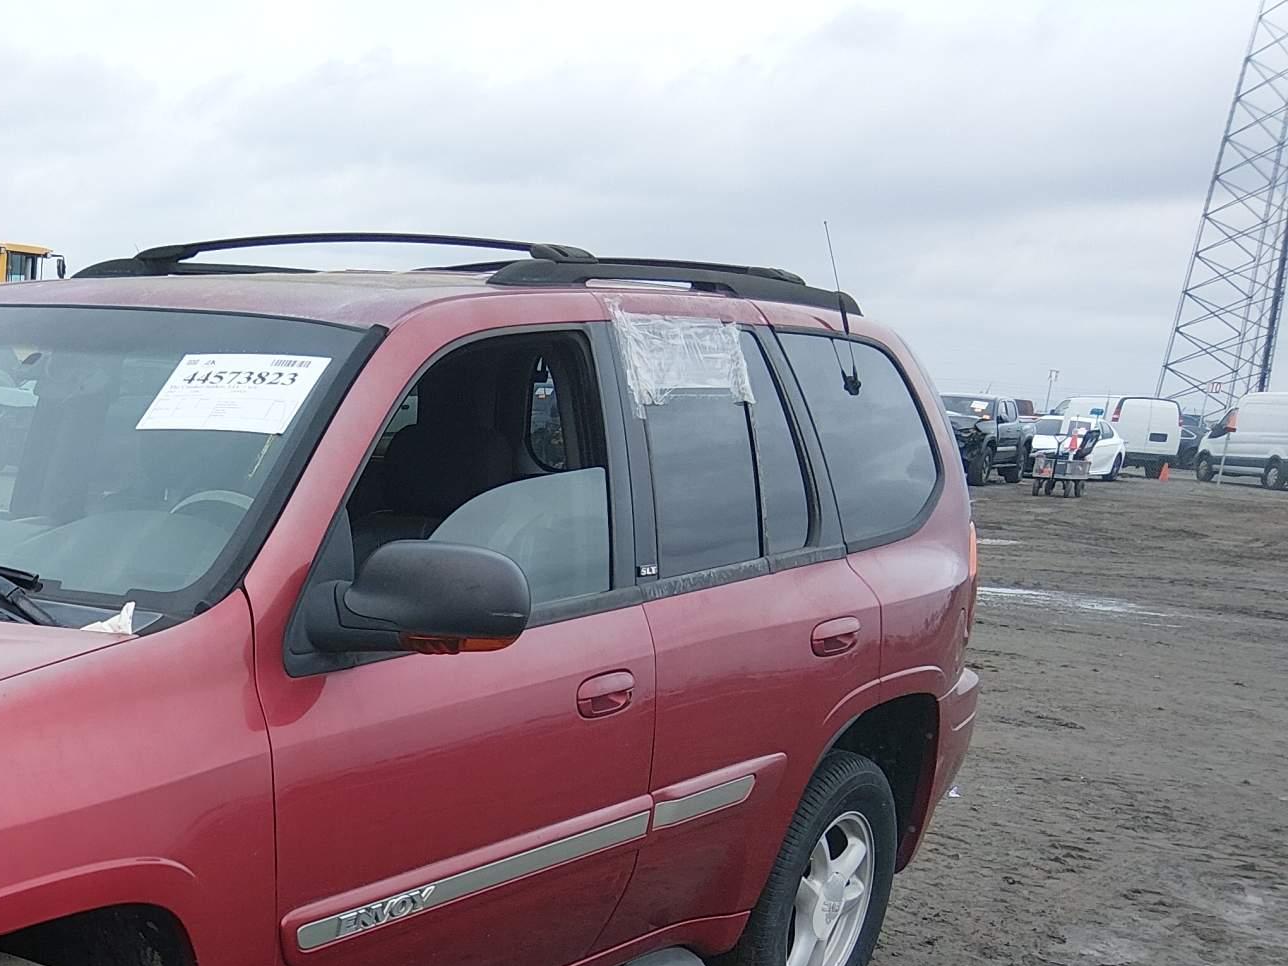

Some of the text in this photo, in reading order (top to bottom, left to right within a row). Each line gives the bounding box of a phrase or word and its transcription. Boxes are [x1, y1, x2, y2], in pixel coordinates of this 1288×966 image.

[183, 370, 300, 386] 44573823
[640, 566, 657, 576] SLT
[335, 885, 436, 939] ENVOY
